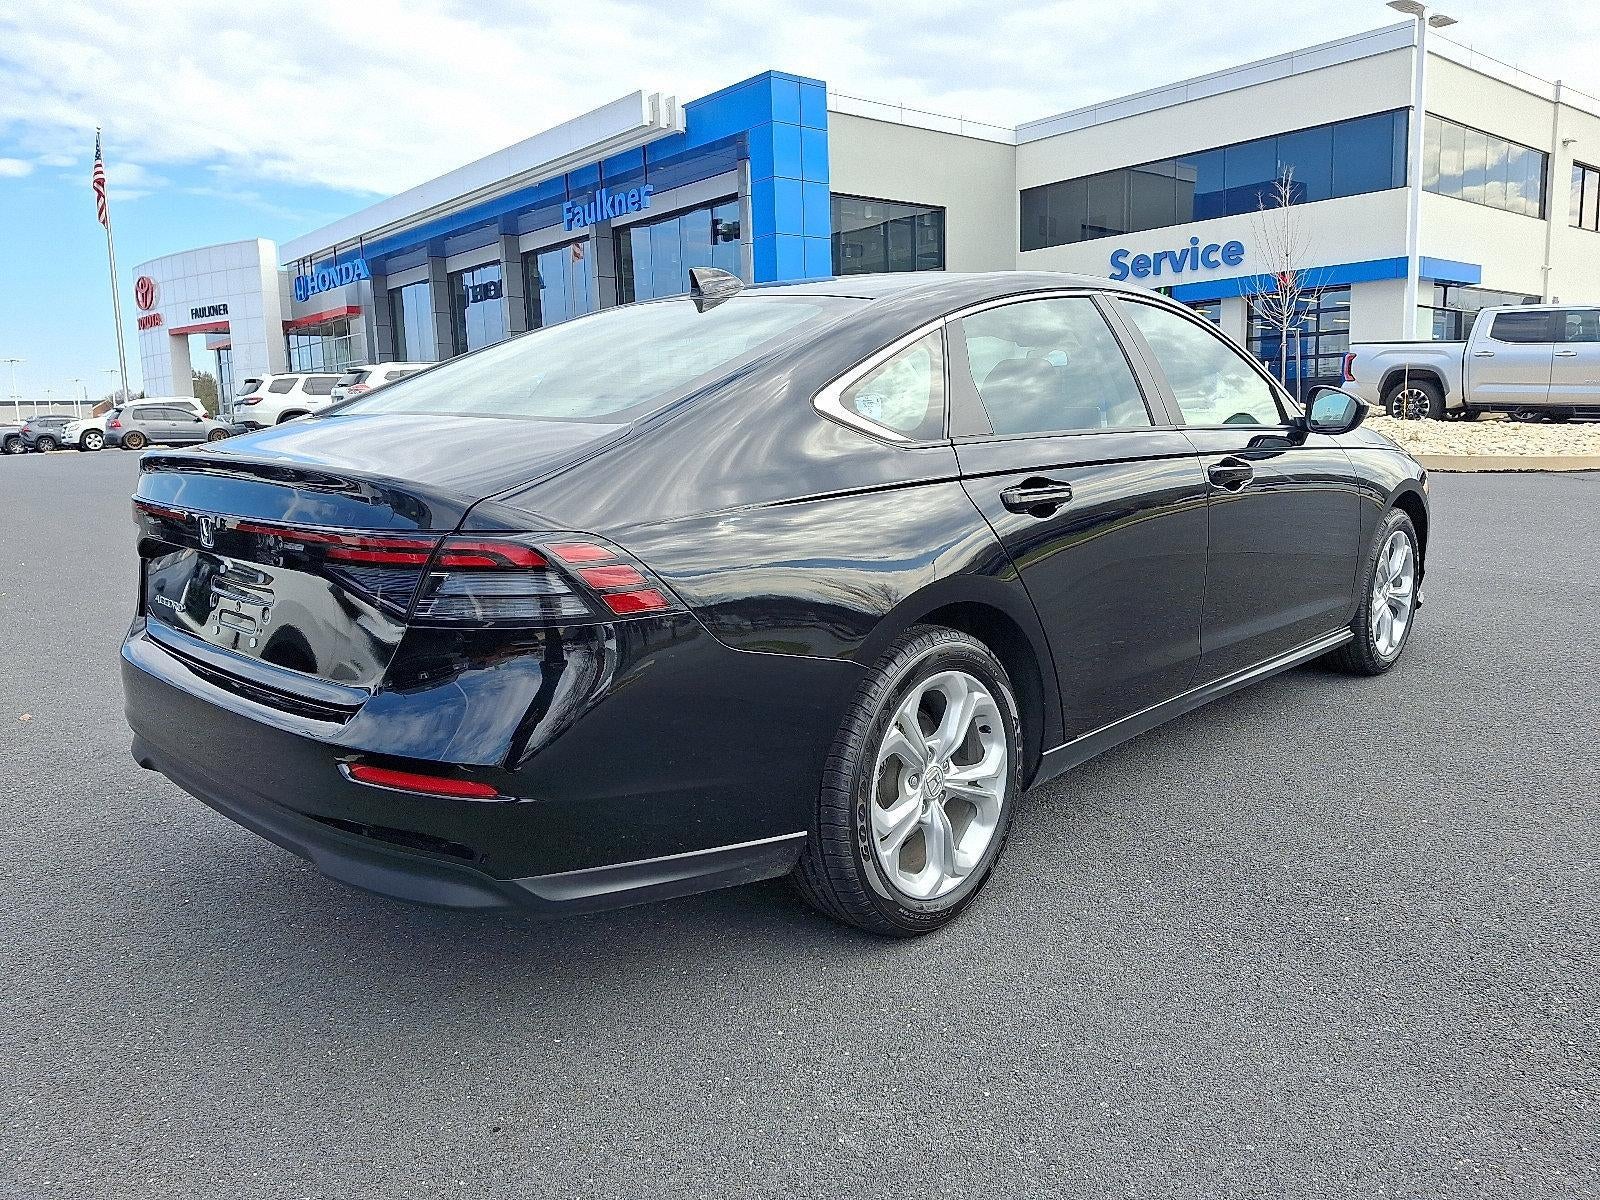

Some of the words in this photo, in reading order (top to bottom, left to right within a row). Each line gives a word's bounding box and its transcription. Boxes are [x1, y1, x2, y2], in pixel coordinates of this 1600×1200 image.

[563, 184, 654, 231] Faulkner
[1109, 236, 1245, 281] Service
[307, 259, 370, 296] HONDA
[137, 312, 163, 331] TOYOTA
[190, 303, 229, 320] FAULKNER
